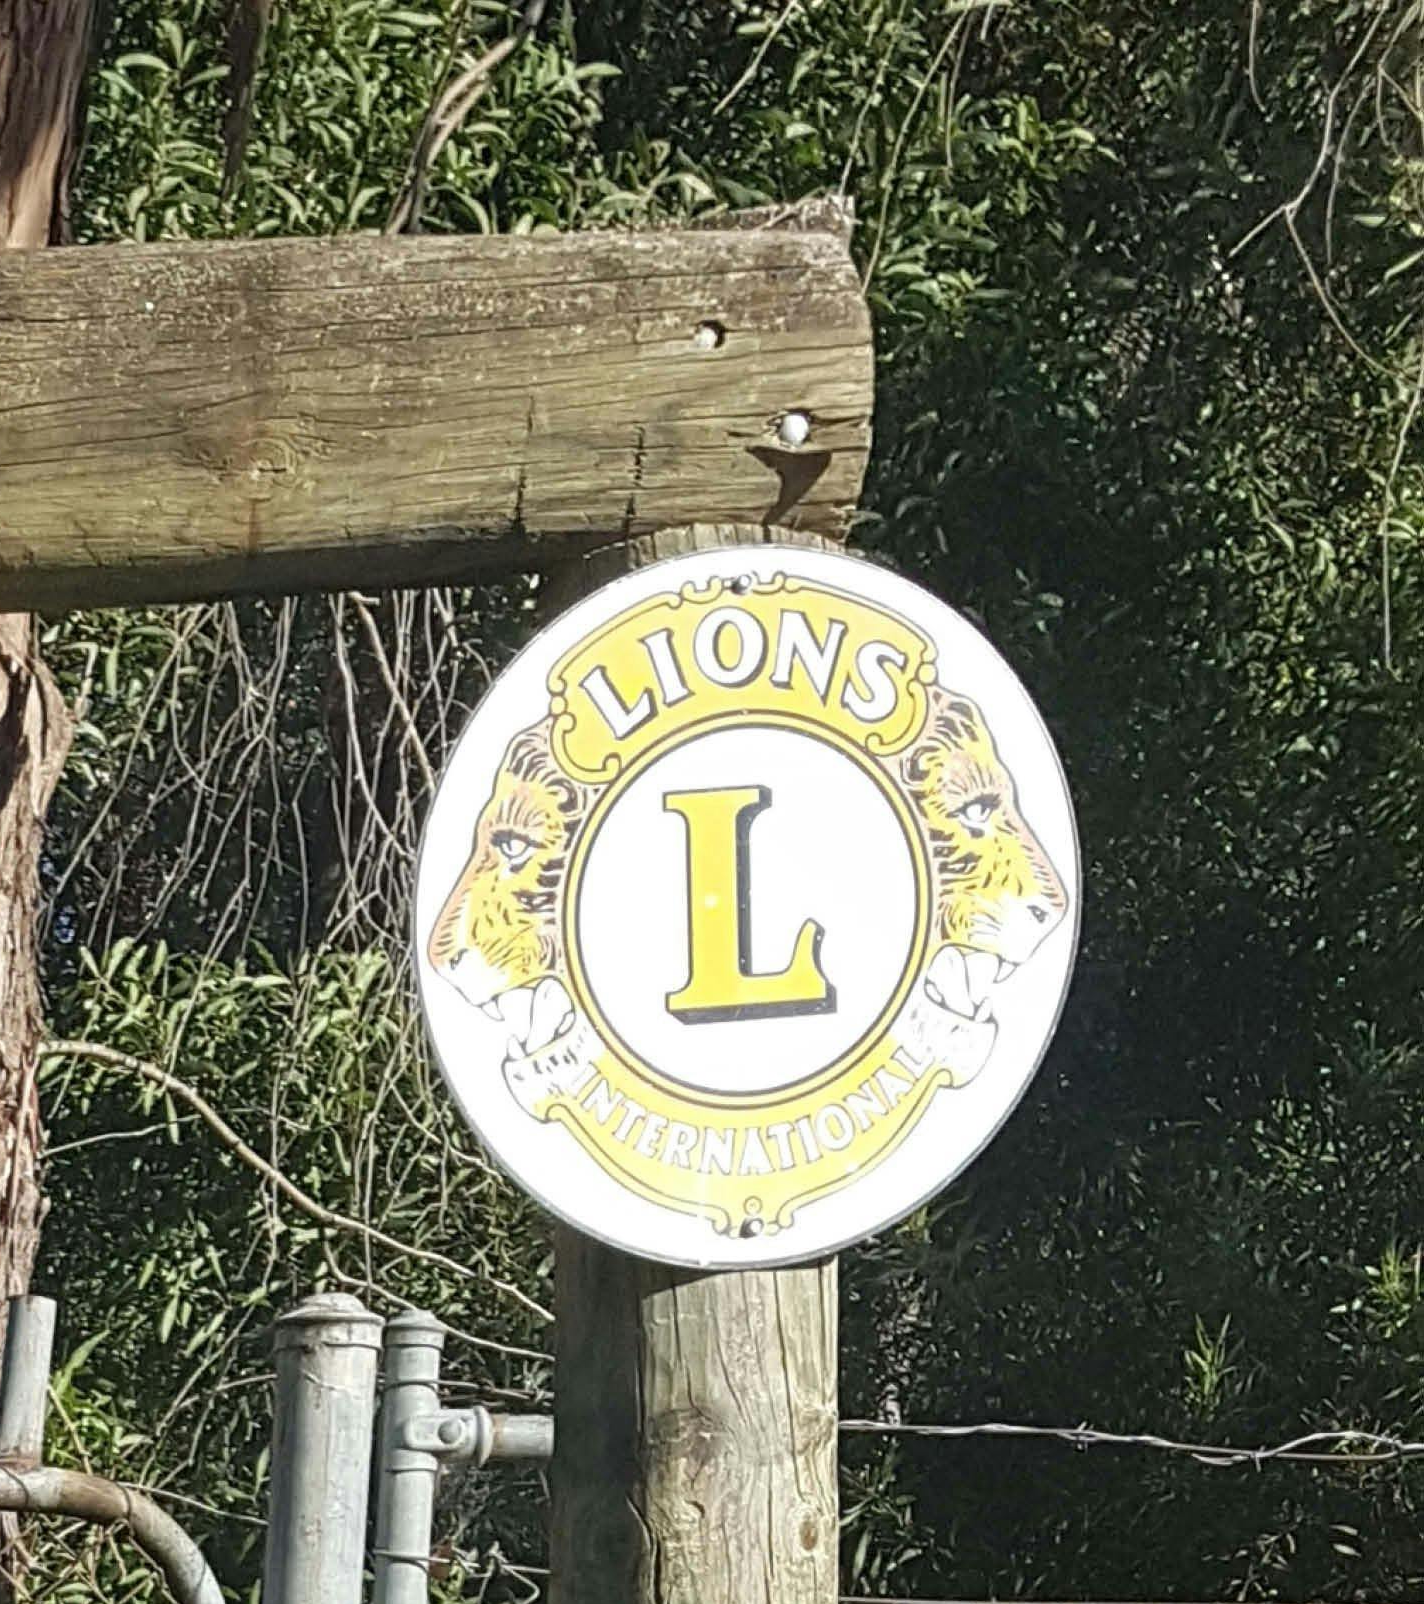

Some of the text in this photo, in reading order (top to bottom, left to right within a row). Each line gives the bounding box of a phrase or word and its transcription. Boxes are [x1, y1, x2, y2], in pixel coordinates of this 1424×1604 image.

[579, 604, 911, 741] LIONS
[663, 783, 838, 1026] L
[568, 1046, 936, 1177] INTERNATIONAL
